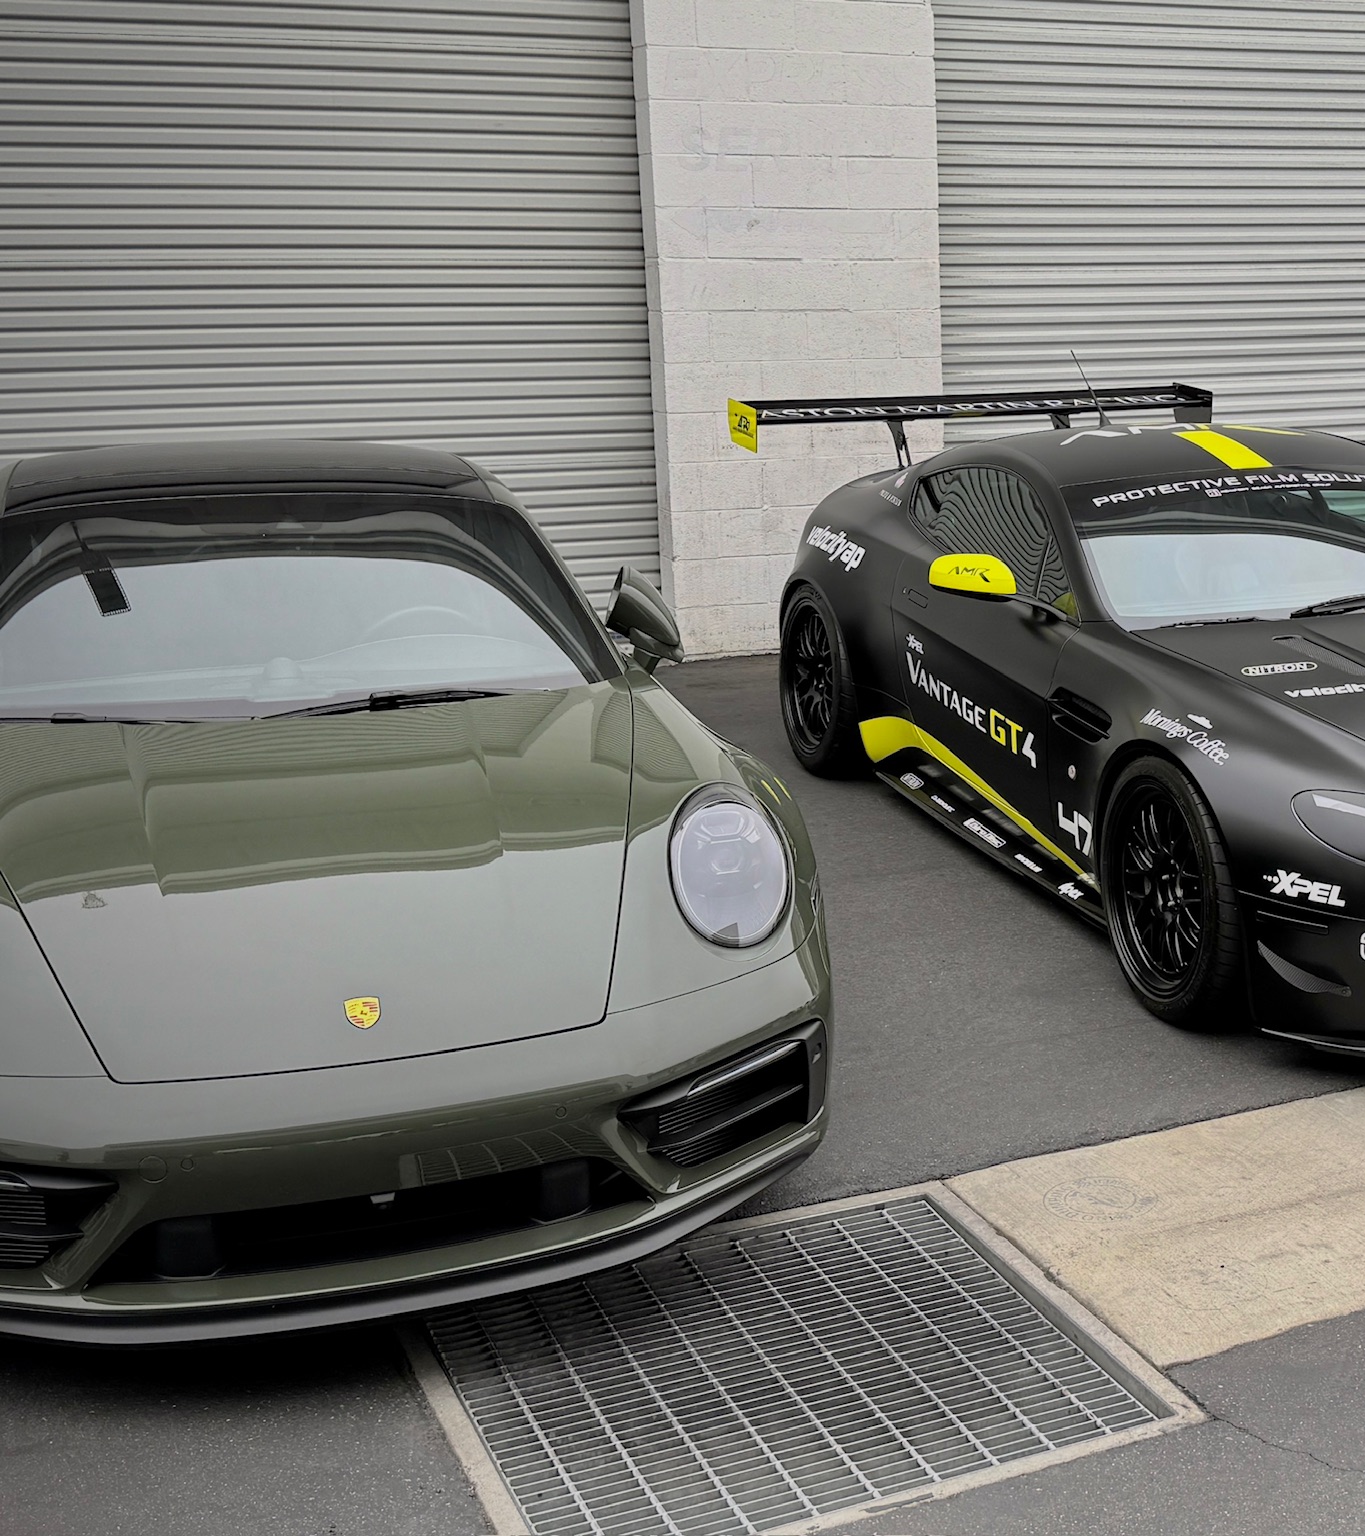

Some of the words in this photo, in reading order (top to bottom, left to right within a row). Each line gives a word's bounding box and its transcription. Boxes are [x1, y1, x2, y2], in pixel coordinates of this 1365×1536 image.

[1092, 476, 1241, 507] PROTECTIVE
[1245, 473, 1299, 485] FILM
[948, 566, 991, 583] AMR
[1246, 662, 1312, 676] NITRON
[906, 651, 987, 734] VANTAGE
[990, 708, 1037, 769] GT4
[1058, 802, 1092, 856] 47
[1269, 869, 1346, 907] XPEL
